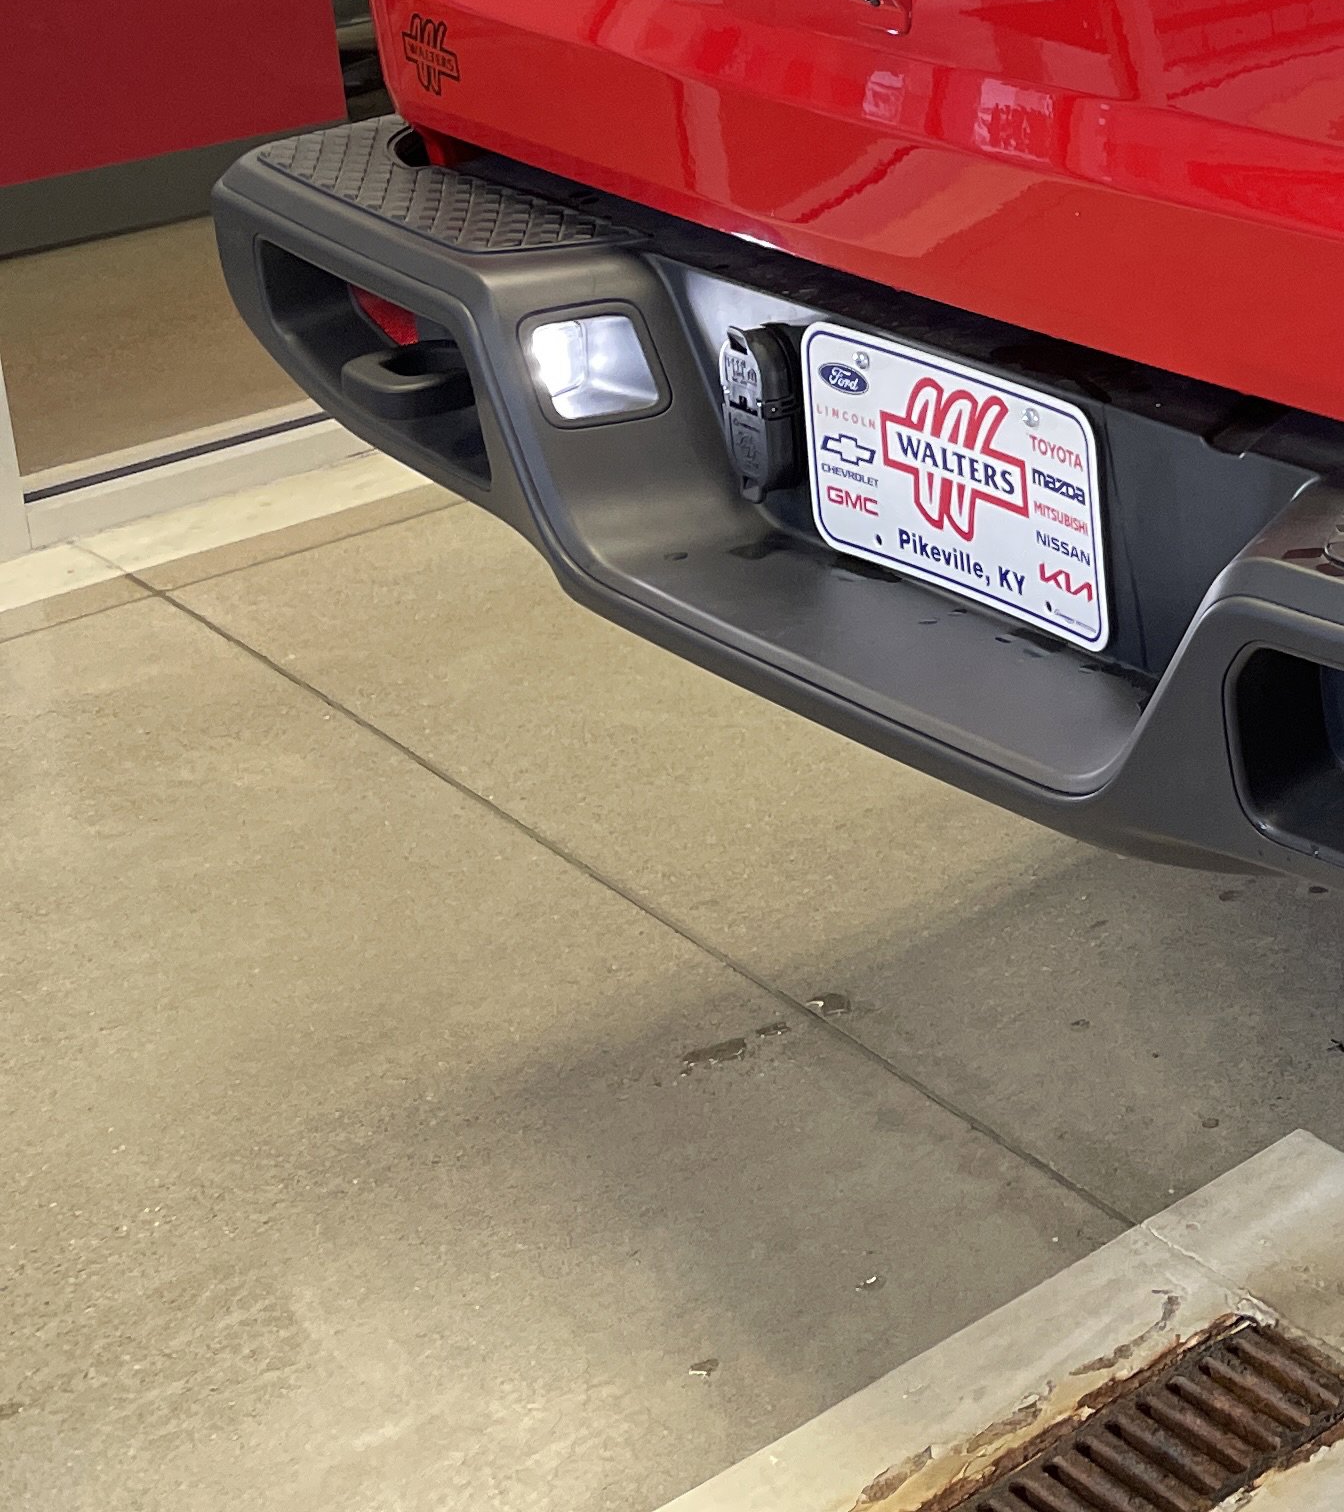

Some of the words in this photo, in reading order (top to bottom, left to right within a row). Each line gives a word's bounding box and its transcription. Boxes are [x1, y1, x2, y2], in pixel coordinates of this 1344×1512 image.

[408, 41, 455, 72] WALTERS
[829, 367, 860, 391] Ford
[816, 403, 877, 430] LINCOLN
[896, 430, 1015, 496] WALTERS
[1028, 433, 1084, 473] TOYOTA
[821, 461, 879, 488] CHEVROLET
[826, 485, 879, 517] GMC
[1033, 500, 1089, 537] MITSUBISHI
[898, 527, 992, 586] Pikeville,
[998, 565, 1026, 596] KY
[1035, 529, 1091, 568] NISSAN
